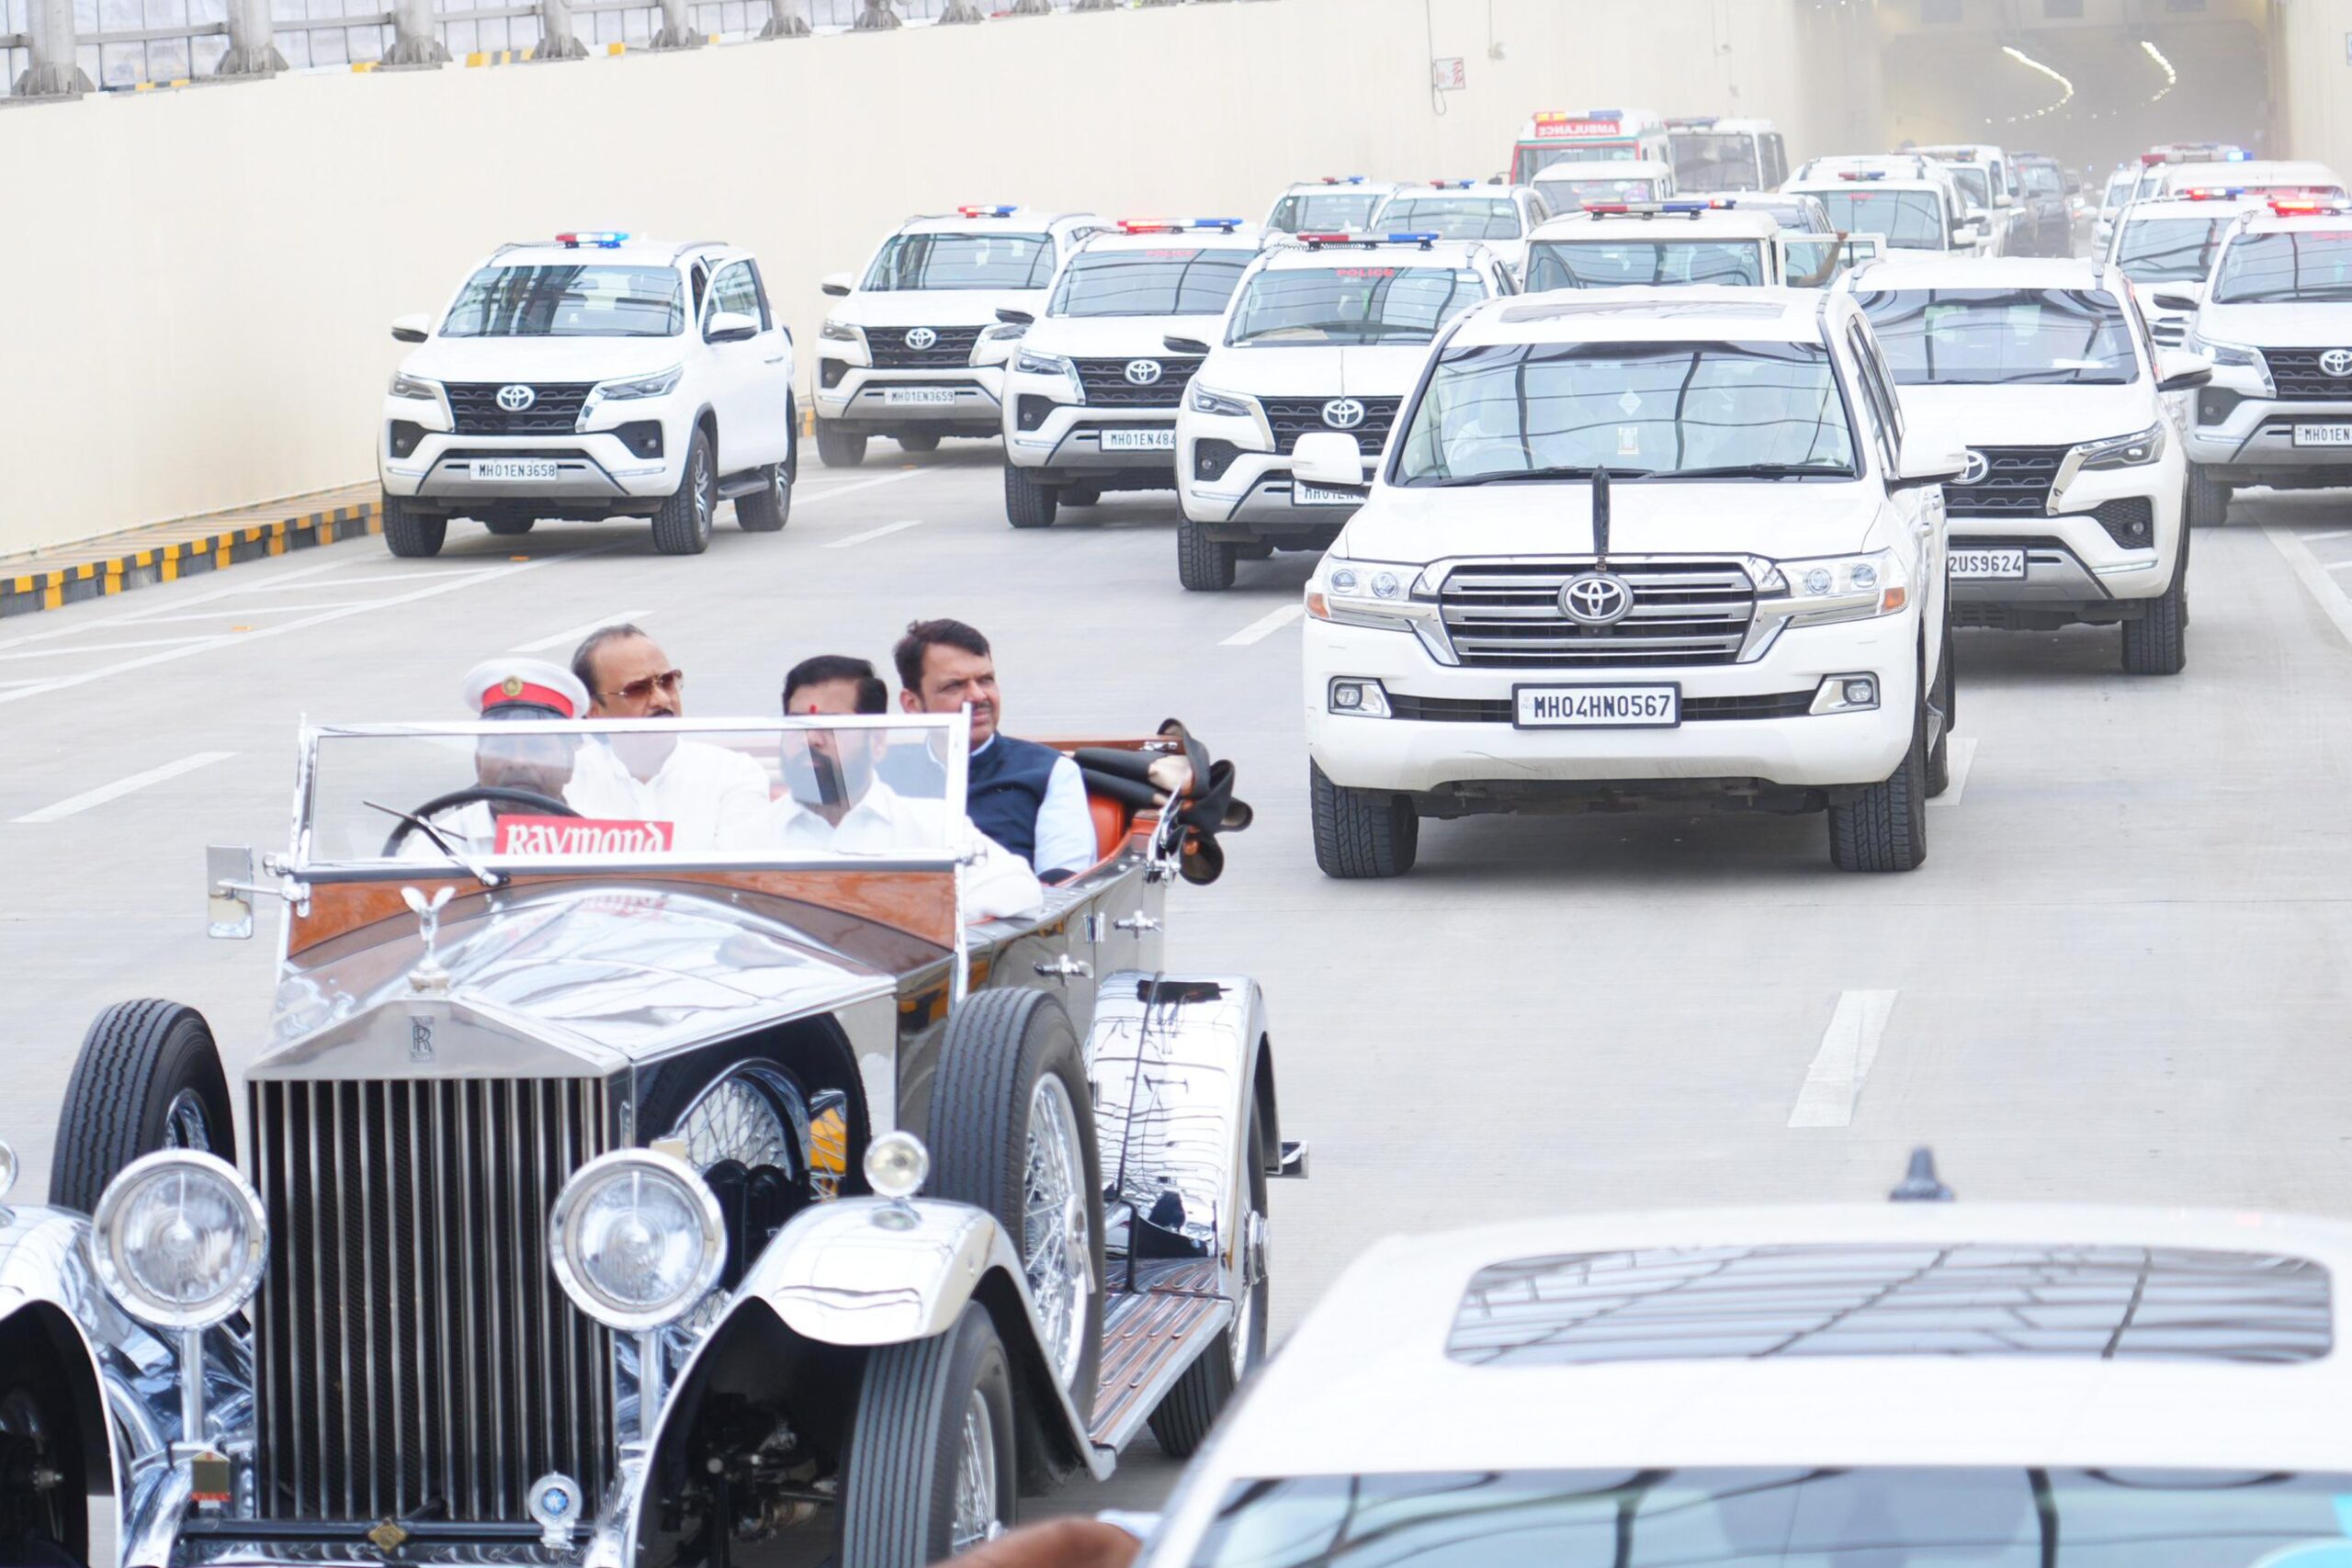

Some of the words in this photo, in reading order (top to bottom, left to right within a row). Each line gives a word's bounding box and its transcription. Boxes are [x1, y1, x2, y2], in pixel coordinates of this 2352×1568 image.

[1337, 267, 1395, 277] POLICE
[891, 390, 954, 402] MH01EN3659
[1111, 433, 1175, 446] MH01EN484
[2304, 427, 2351, 442] MH01EN
[479, 463, 556, 478] MH01EN3658
[1949, 555, 2021, 573] 2US9624
[1533, 694, 1671, 718] MH04HN0567
